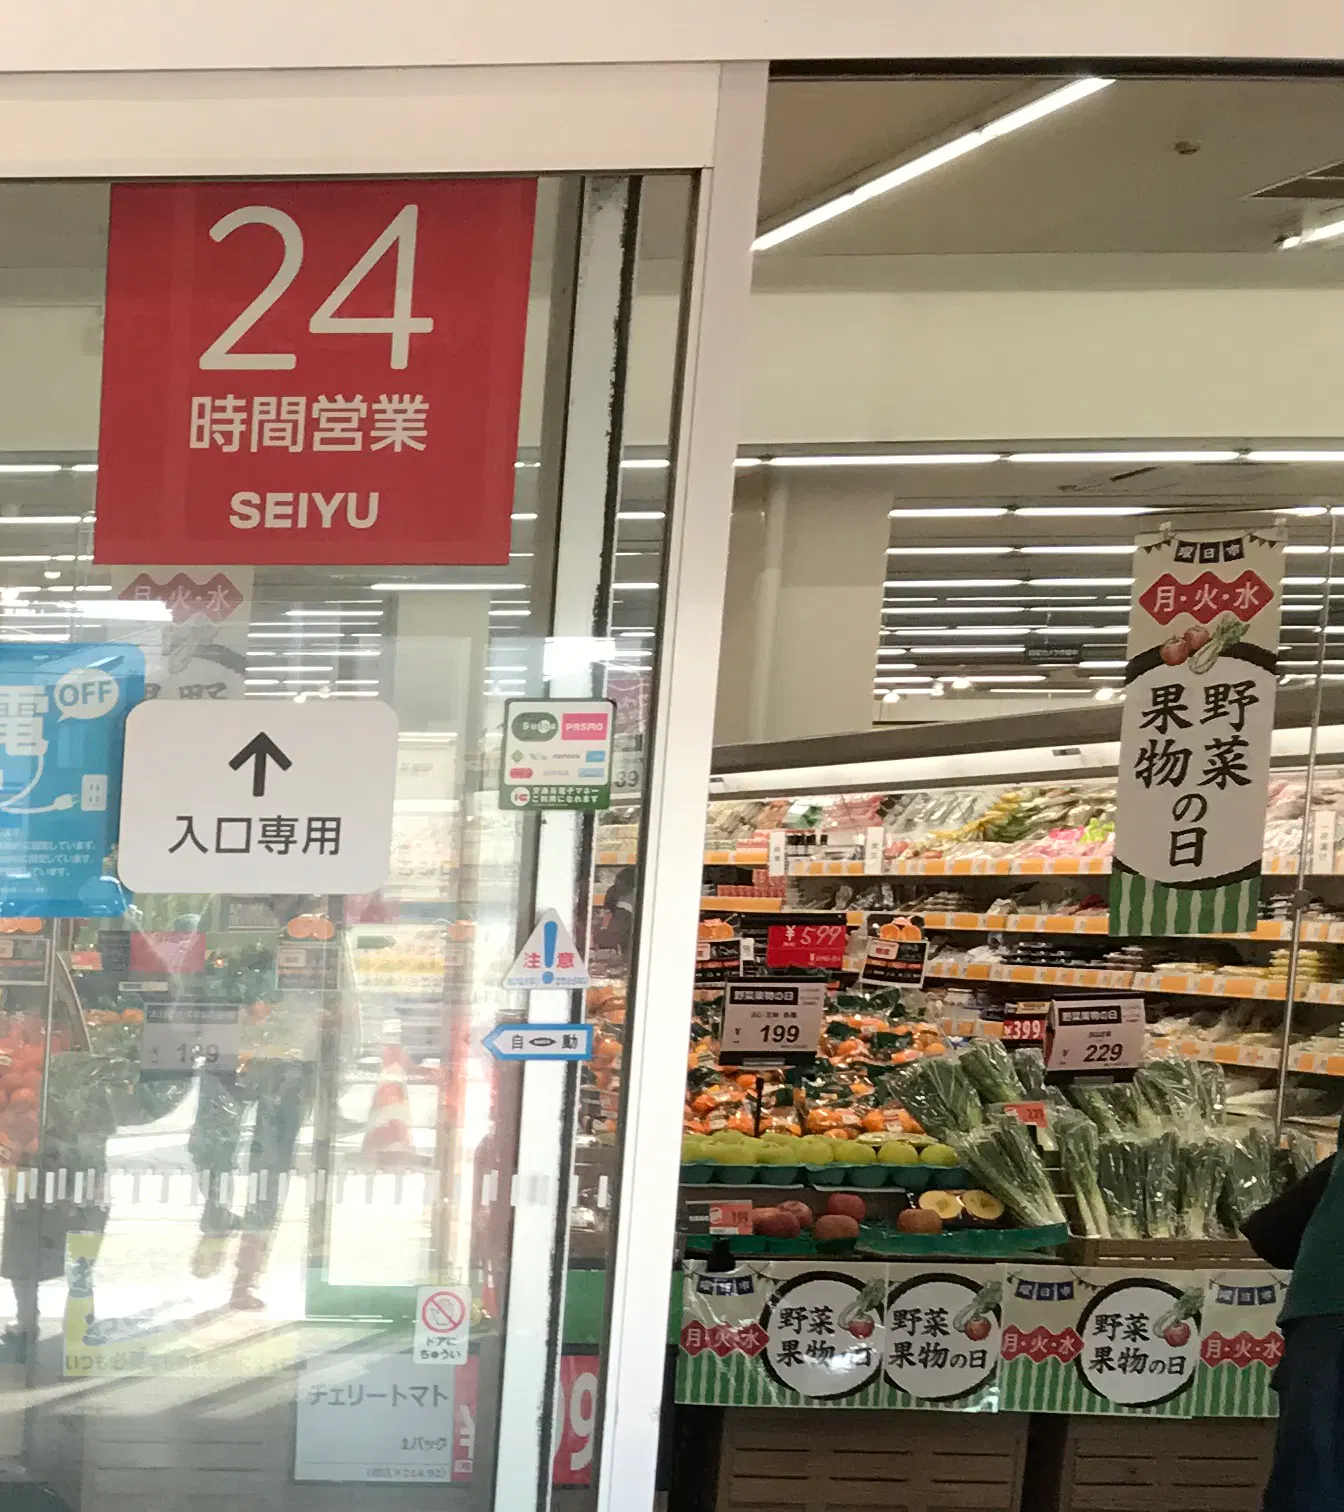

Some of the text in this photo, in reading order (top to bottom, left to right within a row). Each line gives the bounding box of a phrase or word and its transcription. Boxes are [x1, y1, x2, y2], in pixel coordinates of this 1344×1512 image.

[199, 204, 434, 371] 24
[189, 393, 430, 453] 時間営業
[229, 492, 379, 529] SEIYU
[1153, 582, 1261, 613] 月・火・水
[58, 677, 114, 709] OFF
[1134, 683, 1194, 789] 果物
[1197, 680, 1259, 791] 野菜
[168, 815, 343, 857] 入口専用
[800, 926, 842, 946] 599
[761, 1025, 800, 1043] 199
[1083, 1044, 1123, 1062] 229
[778, 1305, 836, 1336] 野菜
[891, 1308, 951, 1337] 野菜
[1093, 1313, 1151, 1343] 野菜
[426, 1336, 457, 1347] ドアに
[888, 1342, 988, 1369] 果物の日
[1089, 1347, 1187, 1375] 果物の日
[308, 1383, 448, 1408] チェリートマト
